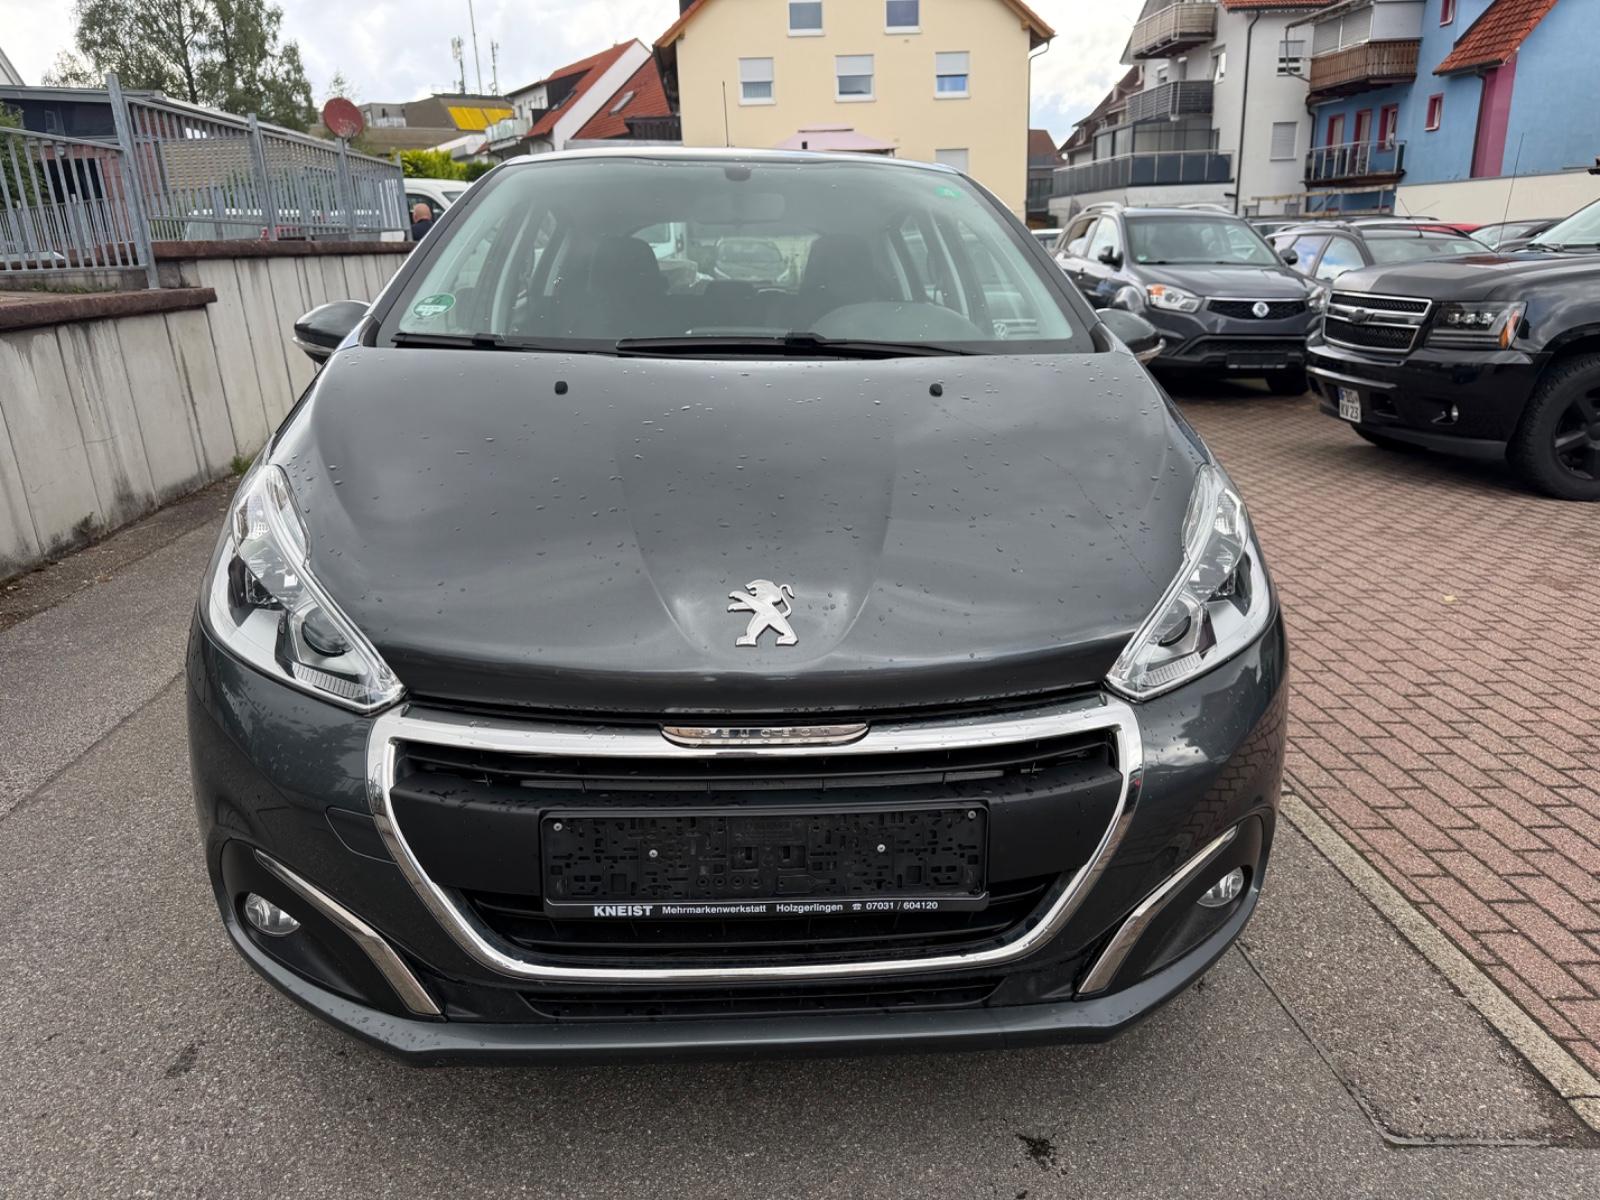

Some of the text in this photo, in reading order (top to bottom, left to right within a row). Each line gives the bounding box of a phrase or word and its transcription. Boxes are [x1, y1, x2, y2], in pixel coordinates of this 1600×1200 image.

[594, 905, 653, 917] KNEIST
[662, 905, 767, 915] Mehrmarkenwerkstatt
[776, 903, 843, 914] Holzgerlingen
[866, 902, 894, 911] 07031
[903, 901, 939, 911] 604120
